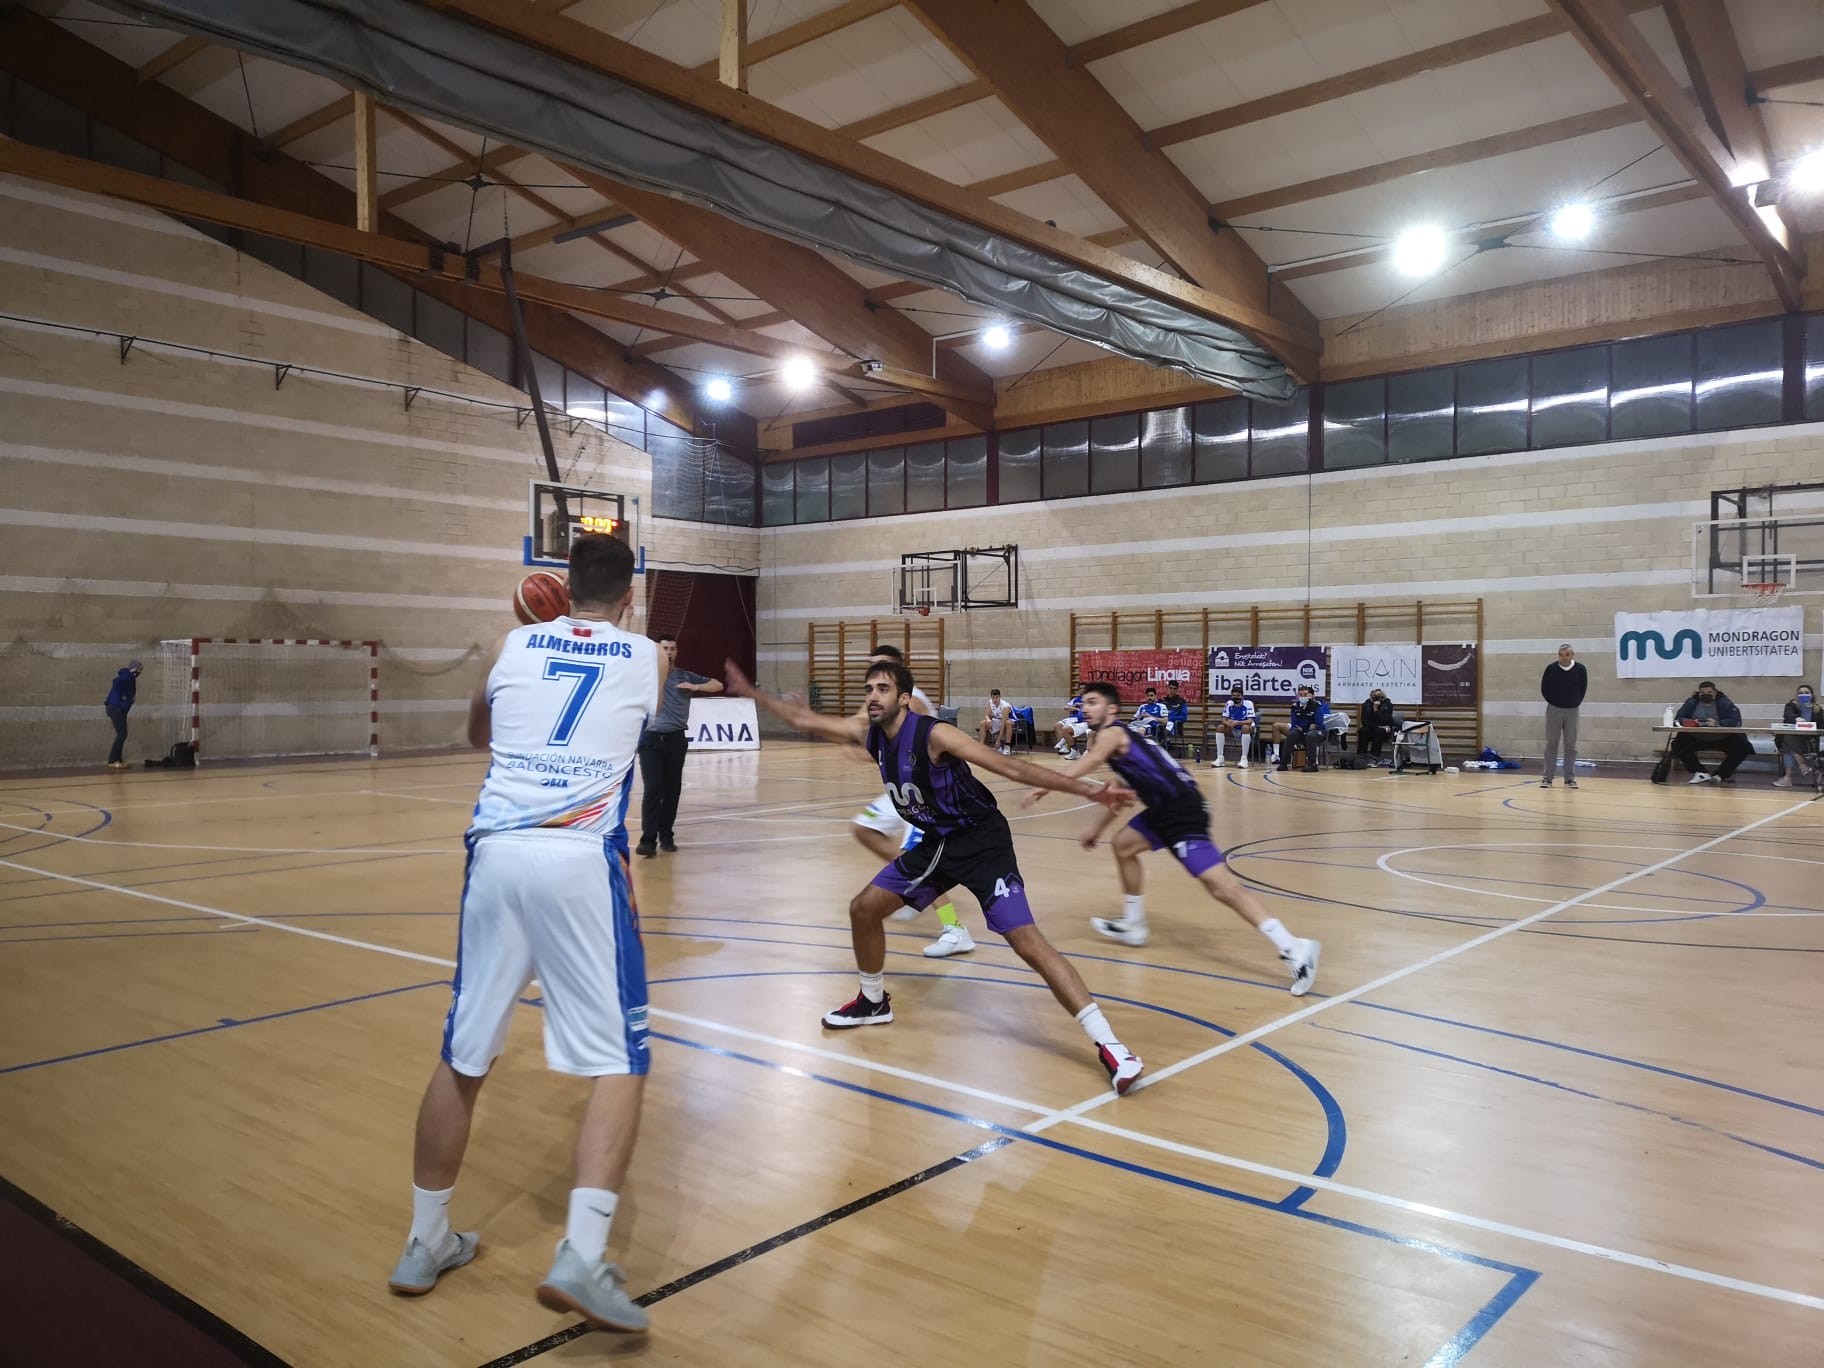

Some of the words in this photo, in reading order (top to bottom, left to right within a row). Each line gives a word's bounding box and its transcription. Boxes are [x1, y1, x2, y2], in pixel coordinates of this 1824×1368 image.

[526, 634, 632, 659] ALMENDROS
[1709, 630, 1800, 643] MONDRAGON
[1708, 645, 1800, 657] UNIBERTSITATEA
[1336, 658, 1417, 679] LIRAIN
[542, 656, 605, 746] 7
[506, 760, 613, 779] BALONCESTO
[566, 755, 614, 771] NAVARRA
[994, 877, 1010, 898] 4
